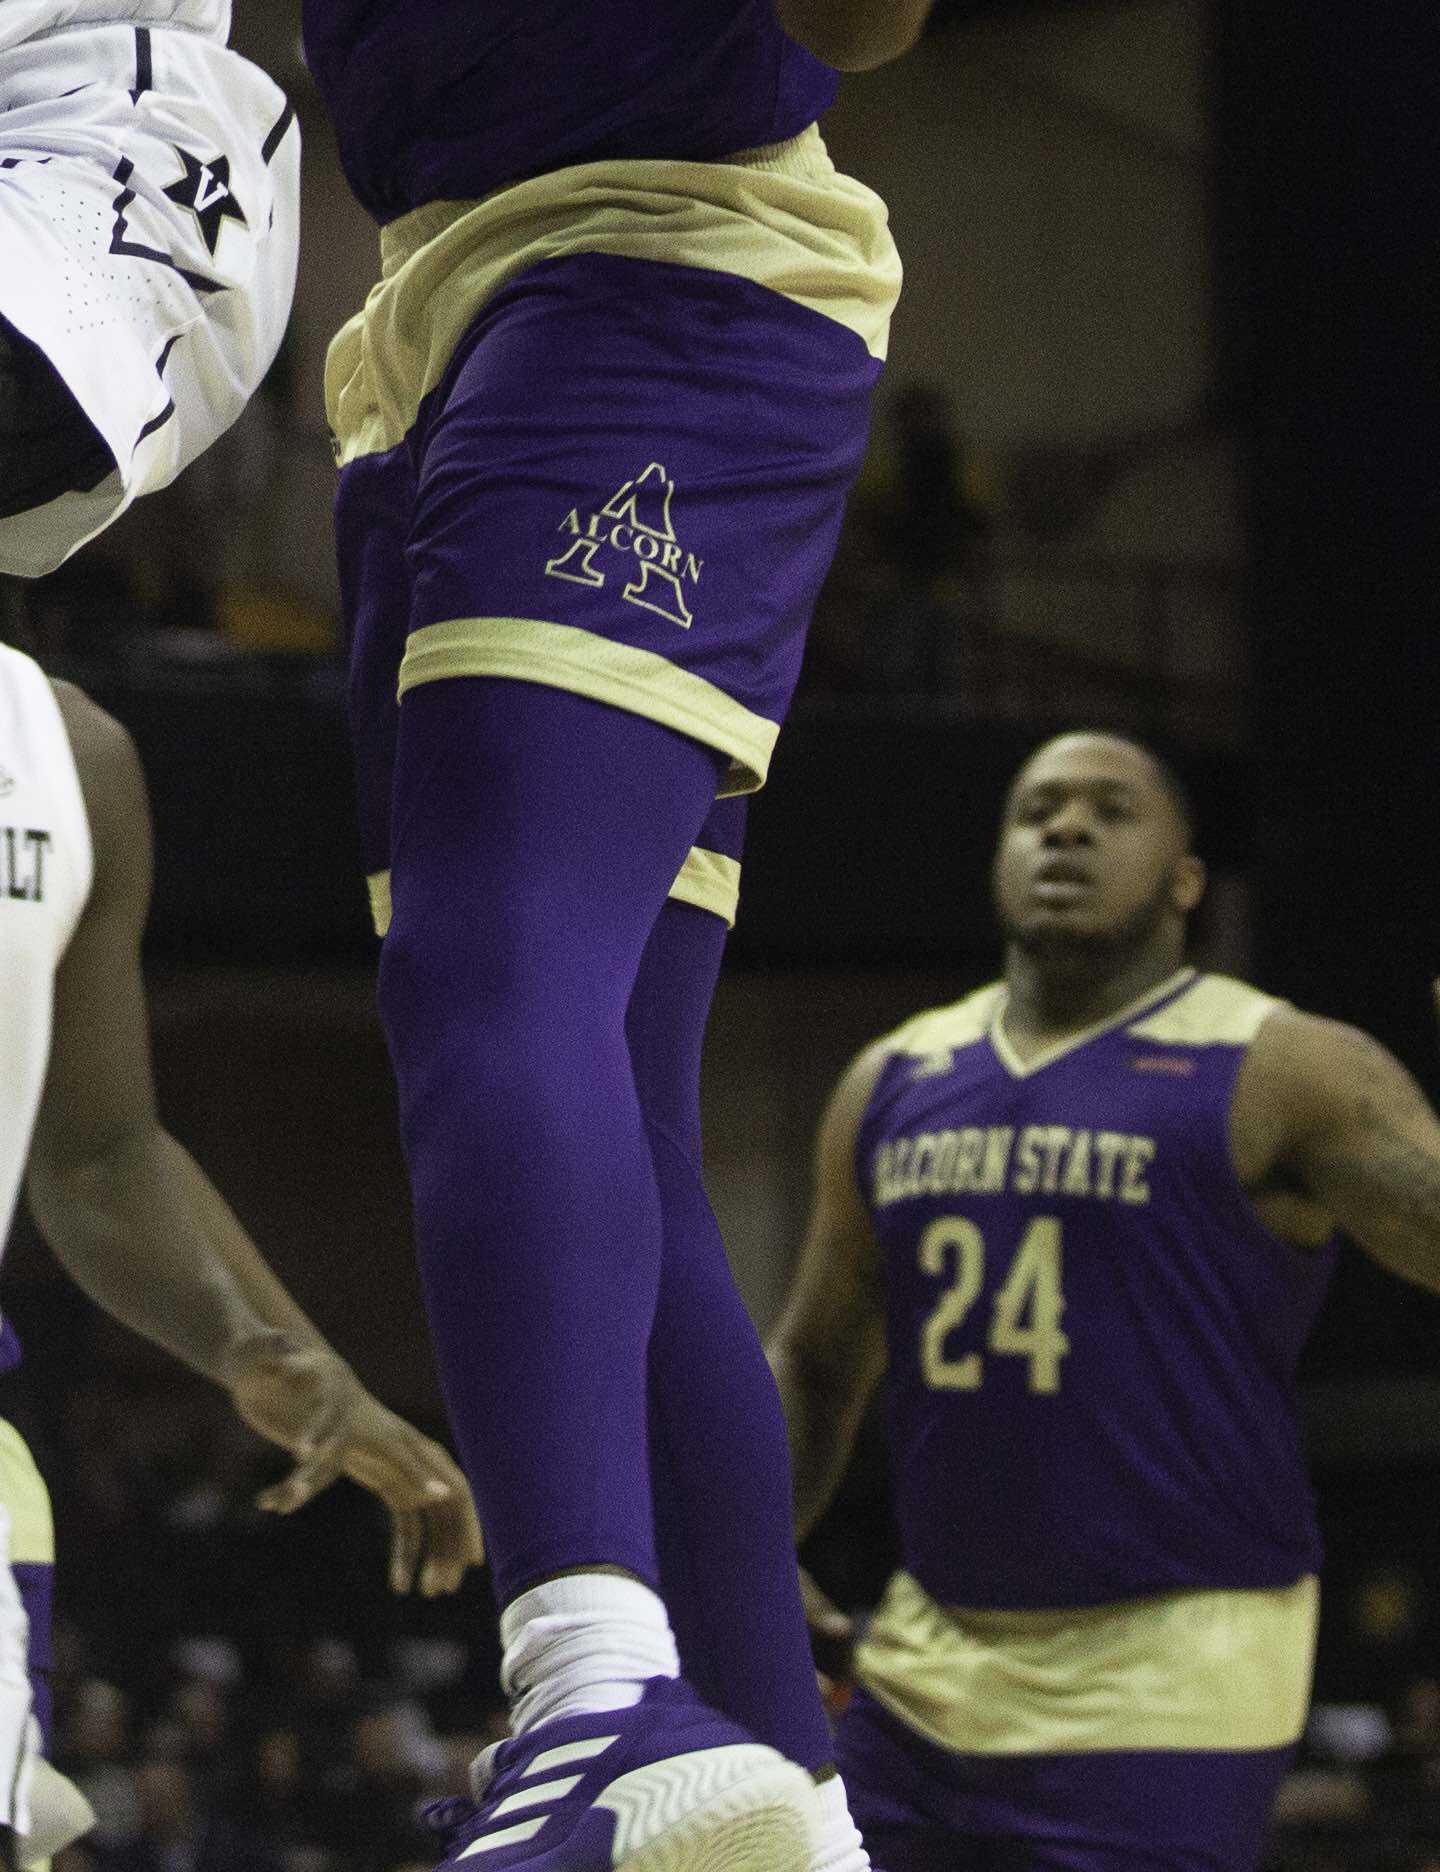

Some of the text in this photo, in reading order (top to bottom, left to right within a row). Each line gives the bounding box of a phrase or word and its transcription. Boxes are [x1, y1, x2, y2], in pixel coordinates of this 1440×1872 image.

[558, 507, 705, 584] ALCORN
[1014, 1125, 1157, 1206] STATE
[917, 1214, 1071, 1398] 24
